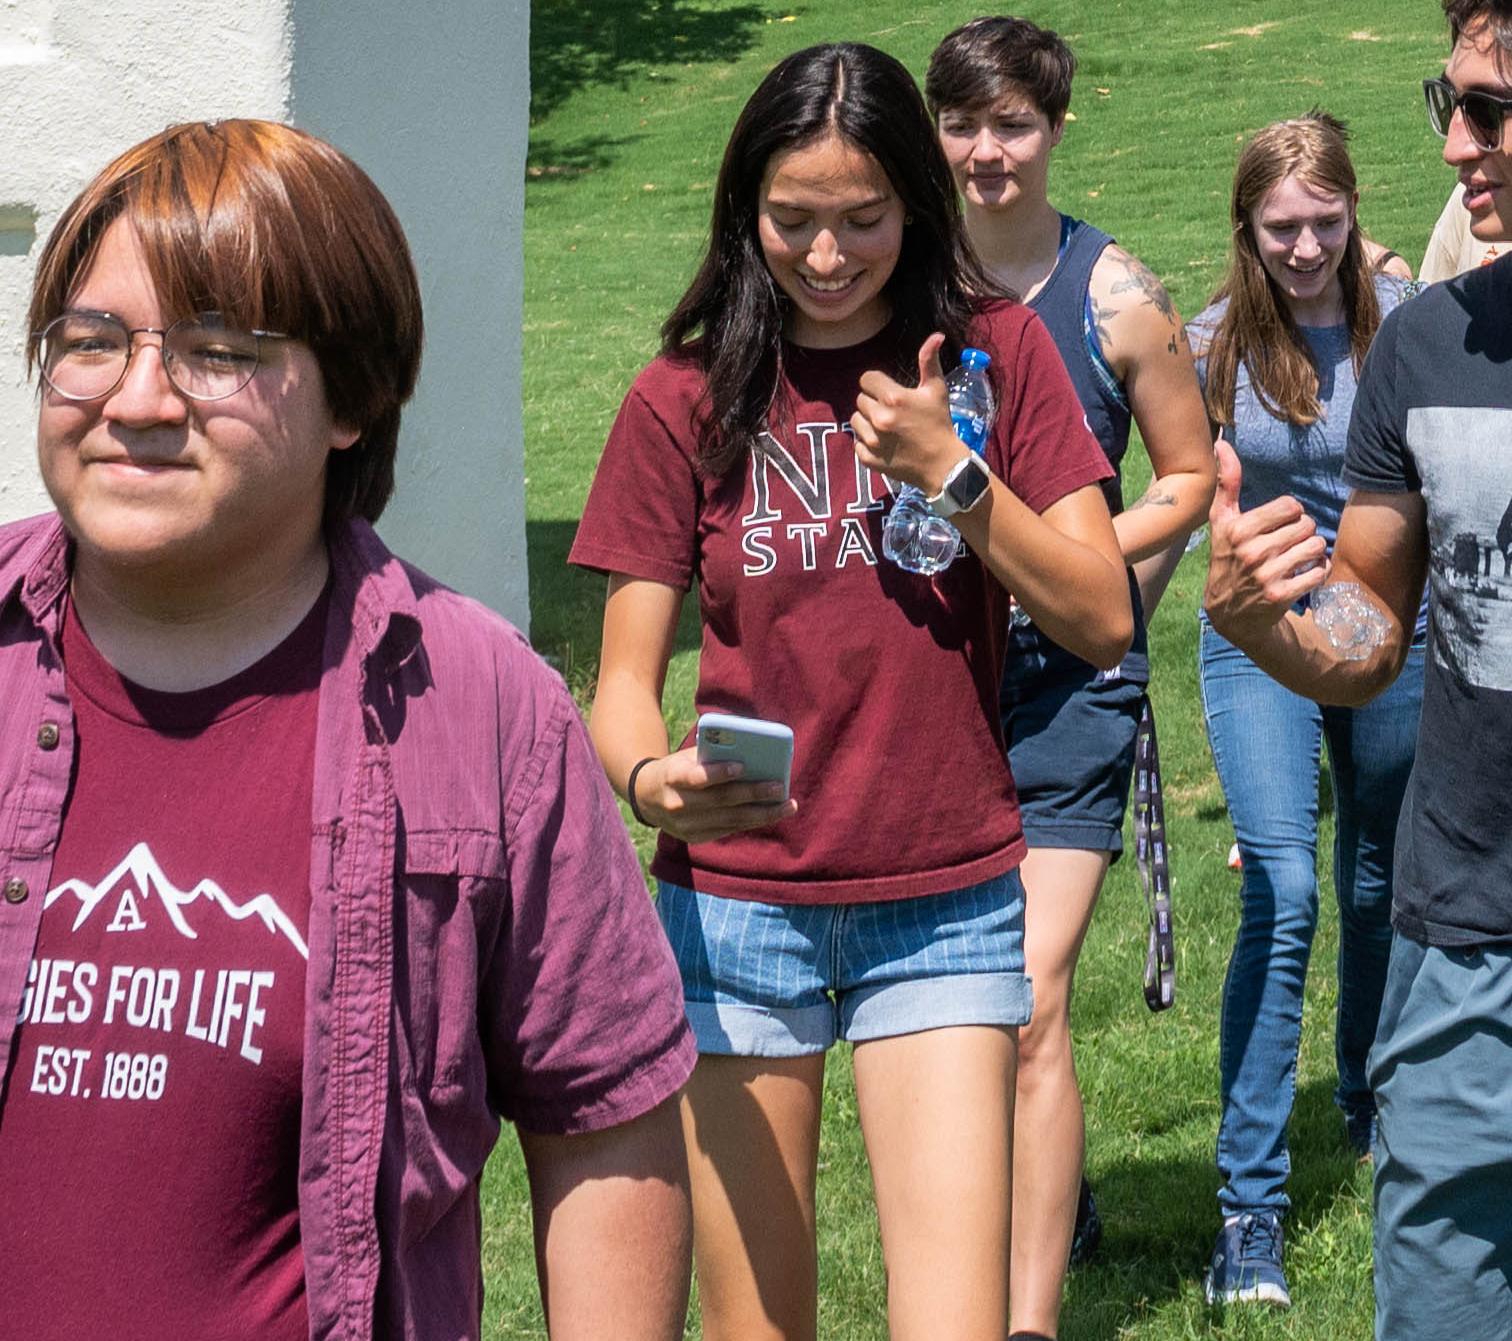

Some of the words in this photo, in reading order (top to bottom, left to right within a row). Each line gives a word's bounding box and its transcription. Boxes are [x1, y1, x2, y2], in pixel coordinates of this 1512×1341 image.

[742, 518, 966, 577] STA
[102, 965, 181, 1032] FOR
[185, 969, 275, 1065] LIFE
[30, 1045, 91, 1099] EST.
[100, 1052, 168, 1100] 1888
